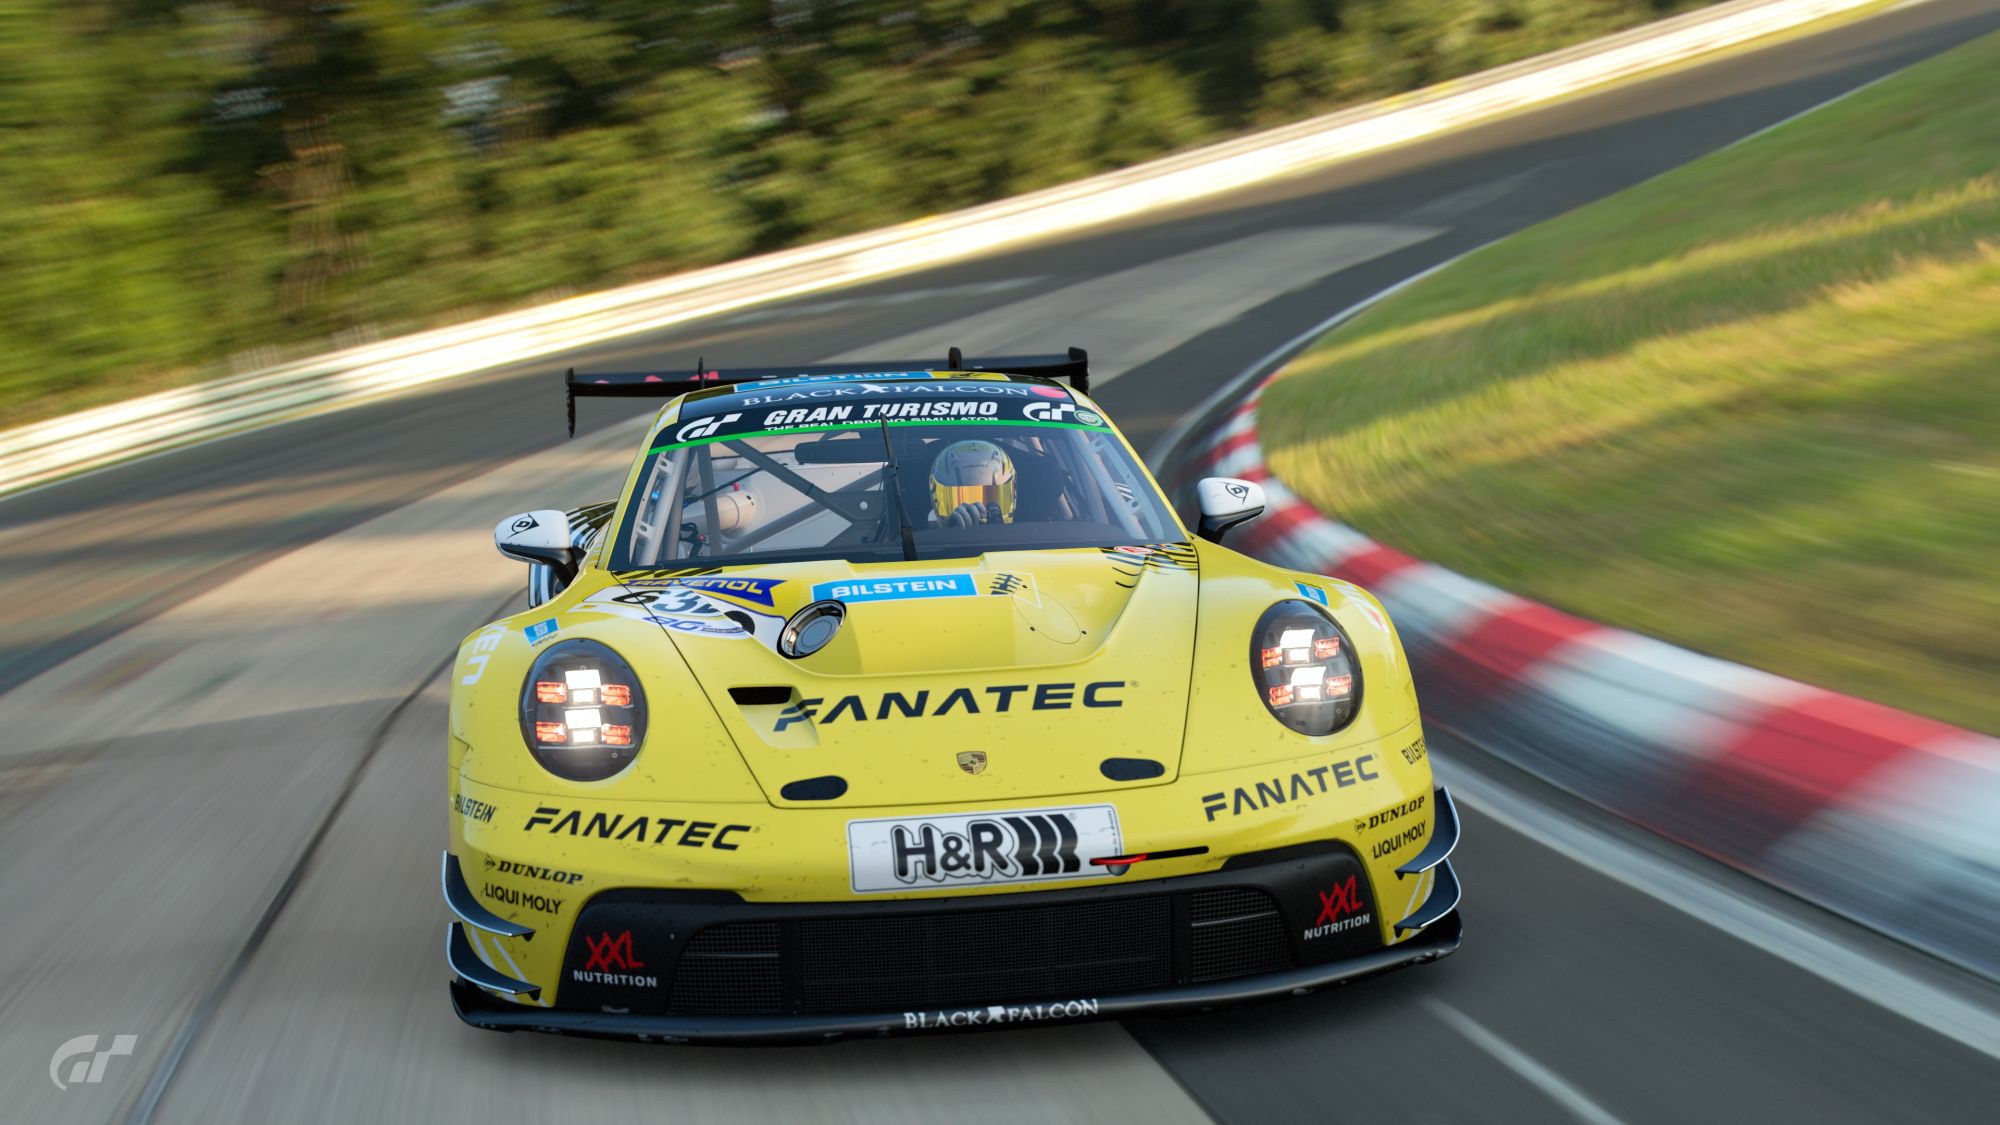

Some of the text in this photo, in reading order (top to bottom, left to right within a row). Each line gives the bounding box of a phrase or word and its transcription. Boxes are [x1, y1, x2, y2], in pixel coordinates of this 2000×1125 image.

[742, 384, 1029, 407] BLACK FALCON
[763, 401, 999, 426] GRAN TURISMO
[765, 425, 795, 433] THE
[831, 579, 958, 600] BILSTEIN
[773, 680, 1126, 732] FANATEC
[1202, 753, 1380, 822] FANATEC
[454, 793, 497, 823] BILSTEIN
[1368, 795, 1426, 829] DUNLOP
[523, 806, 753, 851] FANATEC
[1372, 819, 1427, 860] LIQUI MOLY
[892, 821, 1012, 880] H&R
[497, 860, 584, 885] DUNLOP
[485, 882, 562, 915] LIQUI MOLY
[1316, 874, 1364, 926] XXL
[1303, 912, 1371, 941] NUTRITION
[585, 928, 646, 973] XXL
[573, 969, 658, 988] NUTRITION
[903, 998, 1099, 1029] BLACK FALCON
